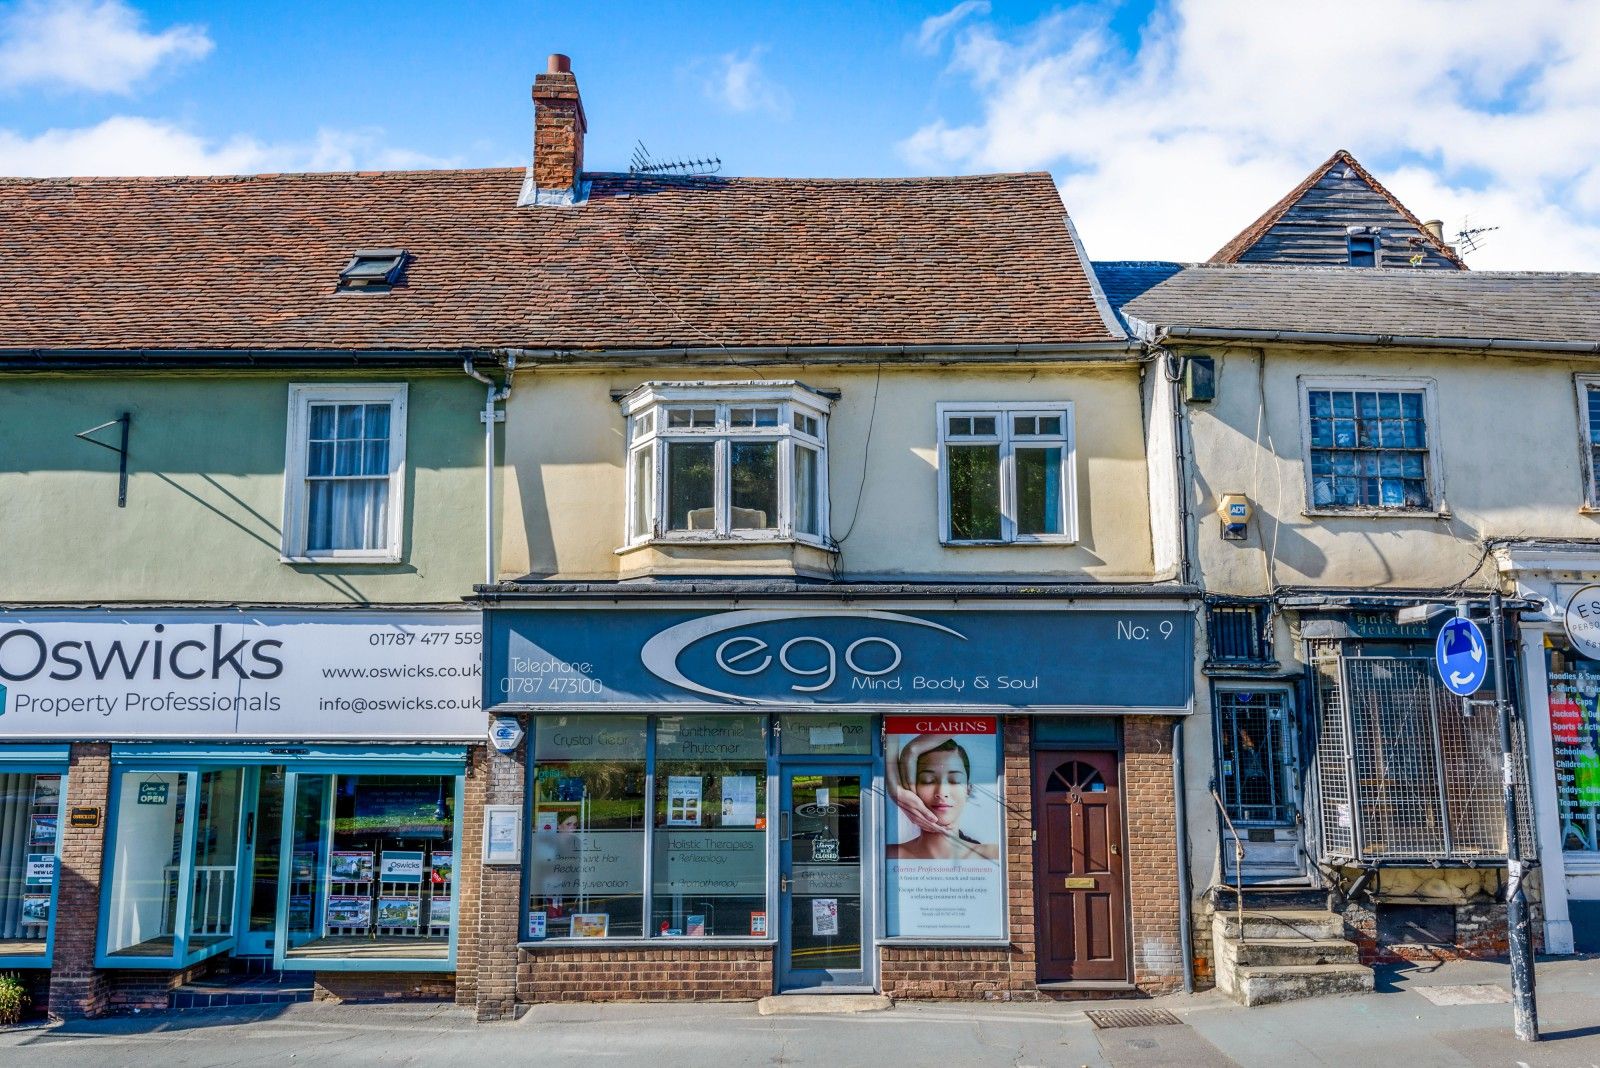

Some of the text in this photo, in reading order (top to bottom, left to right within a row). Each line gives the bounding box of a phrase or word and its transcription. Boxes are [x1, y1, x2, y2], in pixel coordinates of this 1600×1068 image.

[1231, 506, 1245, 514] ADT
[1117, 620, 1173, 640] No: 9
[1357, 624, 1428, 635] Jeweller
[369, 632, 482, 646] 01787 477 559
[0, 624, 284, 681] Oswicks
[322, 664, 482, 678] www.oswicks.co.uk
[512, 657, 593, 677] Telephone:
[715, 636, 902, 692] ego
[1549, 672, 1577, 680] Hoodies
[1578, 672, 1584, 680] &
[500, 677, 603, 694] 01787 473100
[852, 676, 1039, 692] Mind, Body & Soul
[15, 691, 281, 717] Property Professionals
[319, 696, 481, 714] info@oswicks.co.uk
[1552, 710, 1579, 718] Jackets
[915, 721, 987, 732] CLARINS
[1553, 723, 1576, 731] Sports
[553, 733, 593, 747] Crystal
[682, 740, 741, 754] Phytomer
[1557, 773, 1575, 782] Bags
[806, 806, 836, 816] ego
[1575, 812, 1595, 820] much
[668, 838, 754, 853] Holistic Therapies
[390, 861, 419, 869] Oswicks
